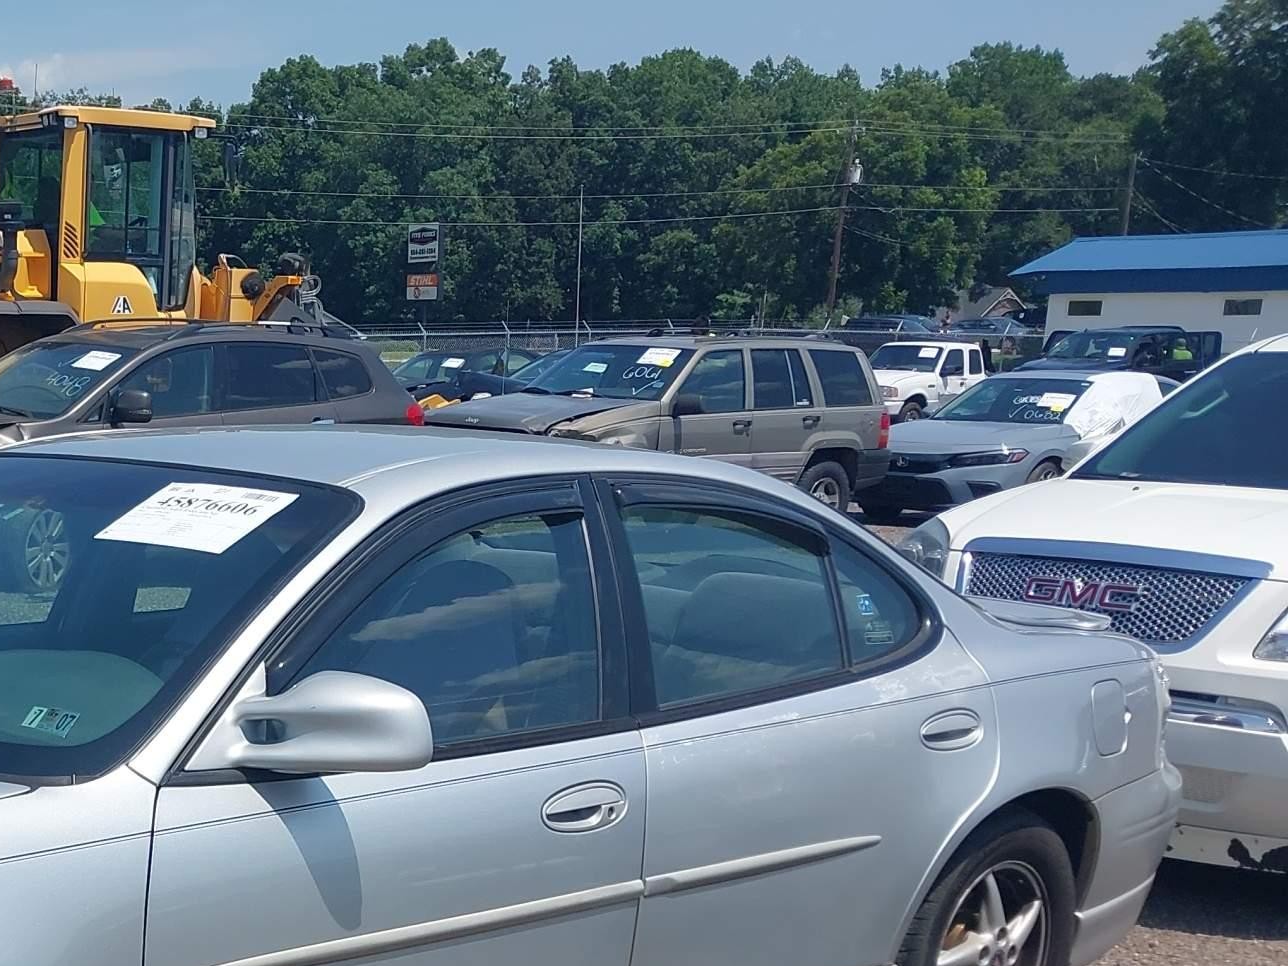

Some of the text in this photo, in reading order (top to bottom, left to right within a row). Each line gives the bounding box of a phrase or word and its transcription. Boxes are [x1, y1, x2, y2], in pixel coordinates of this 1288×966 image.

[408, 276, 433, 286] STIHL
[45, 372, 91, 397] 4048
[156, 496, 264, 517] 45876606
[1024, 576, 1140, 612] GMC
[55, 713, 77, 731] 07
